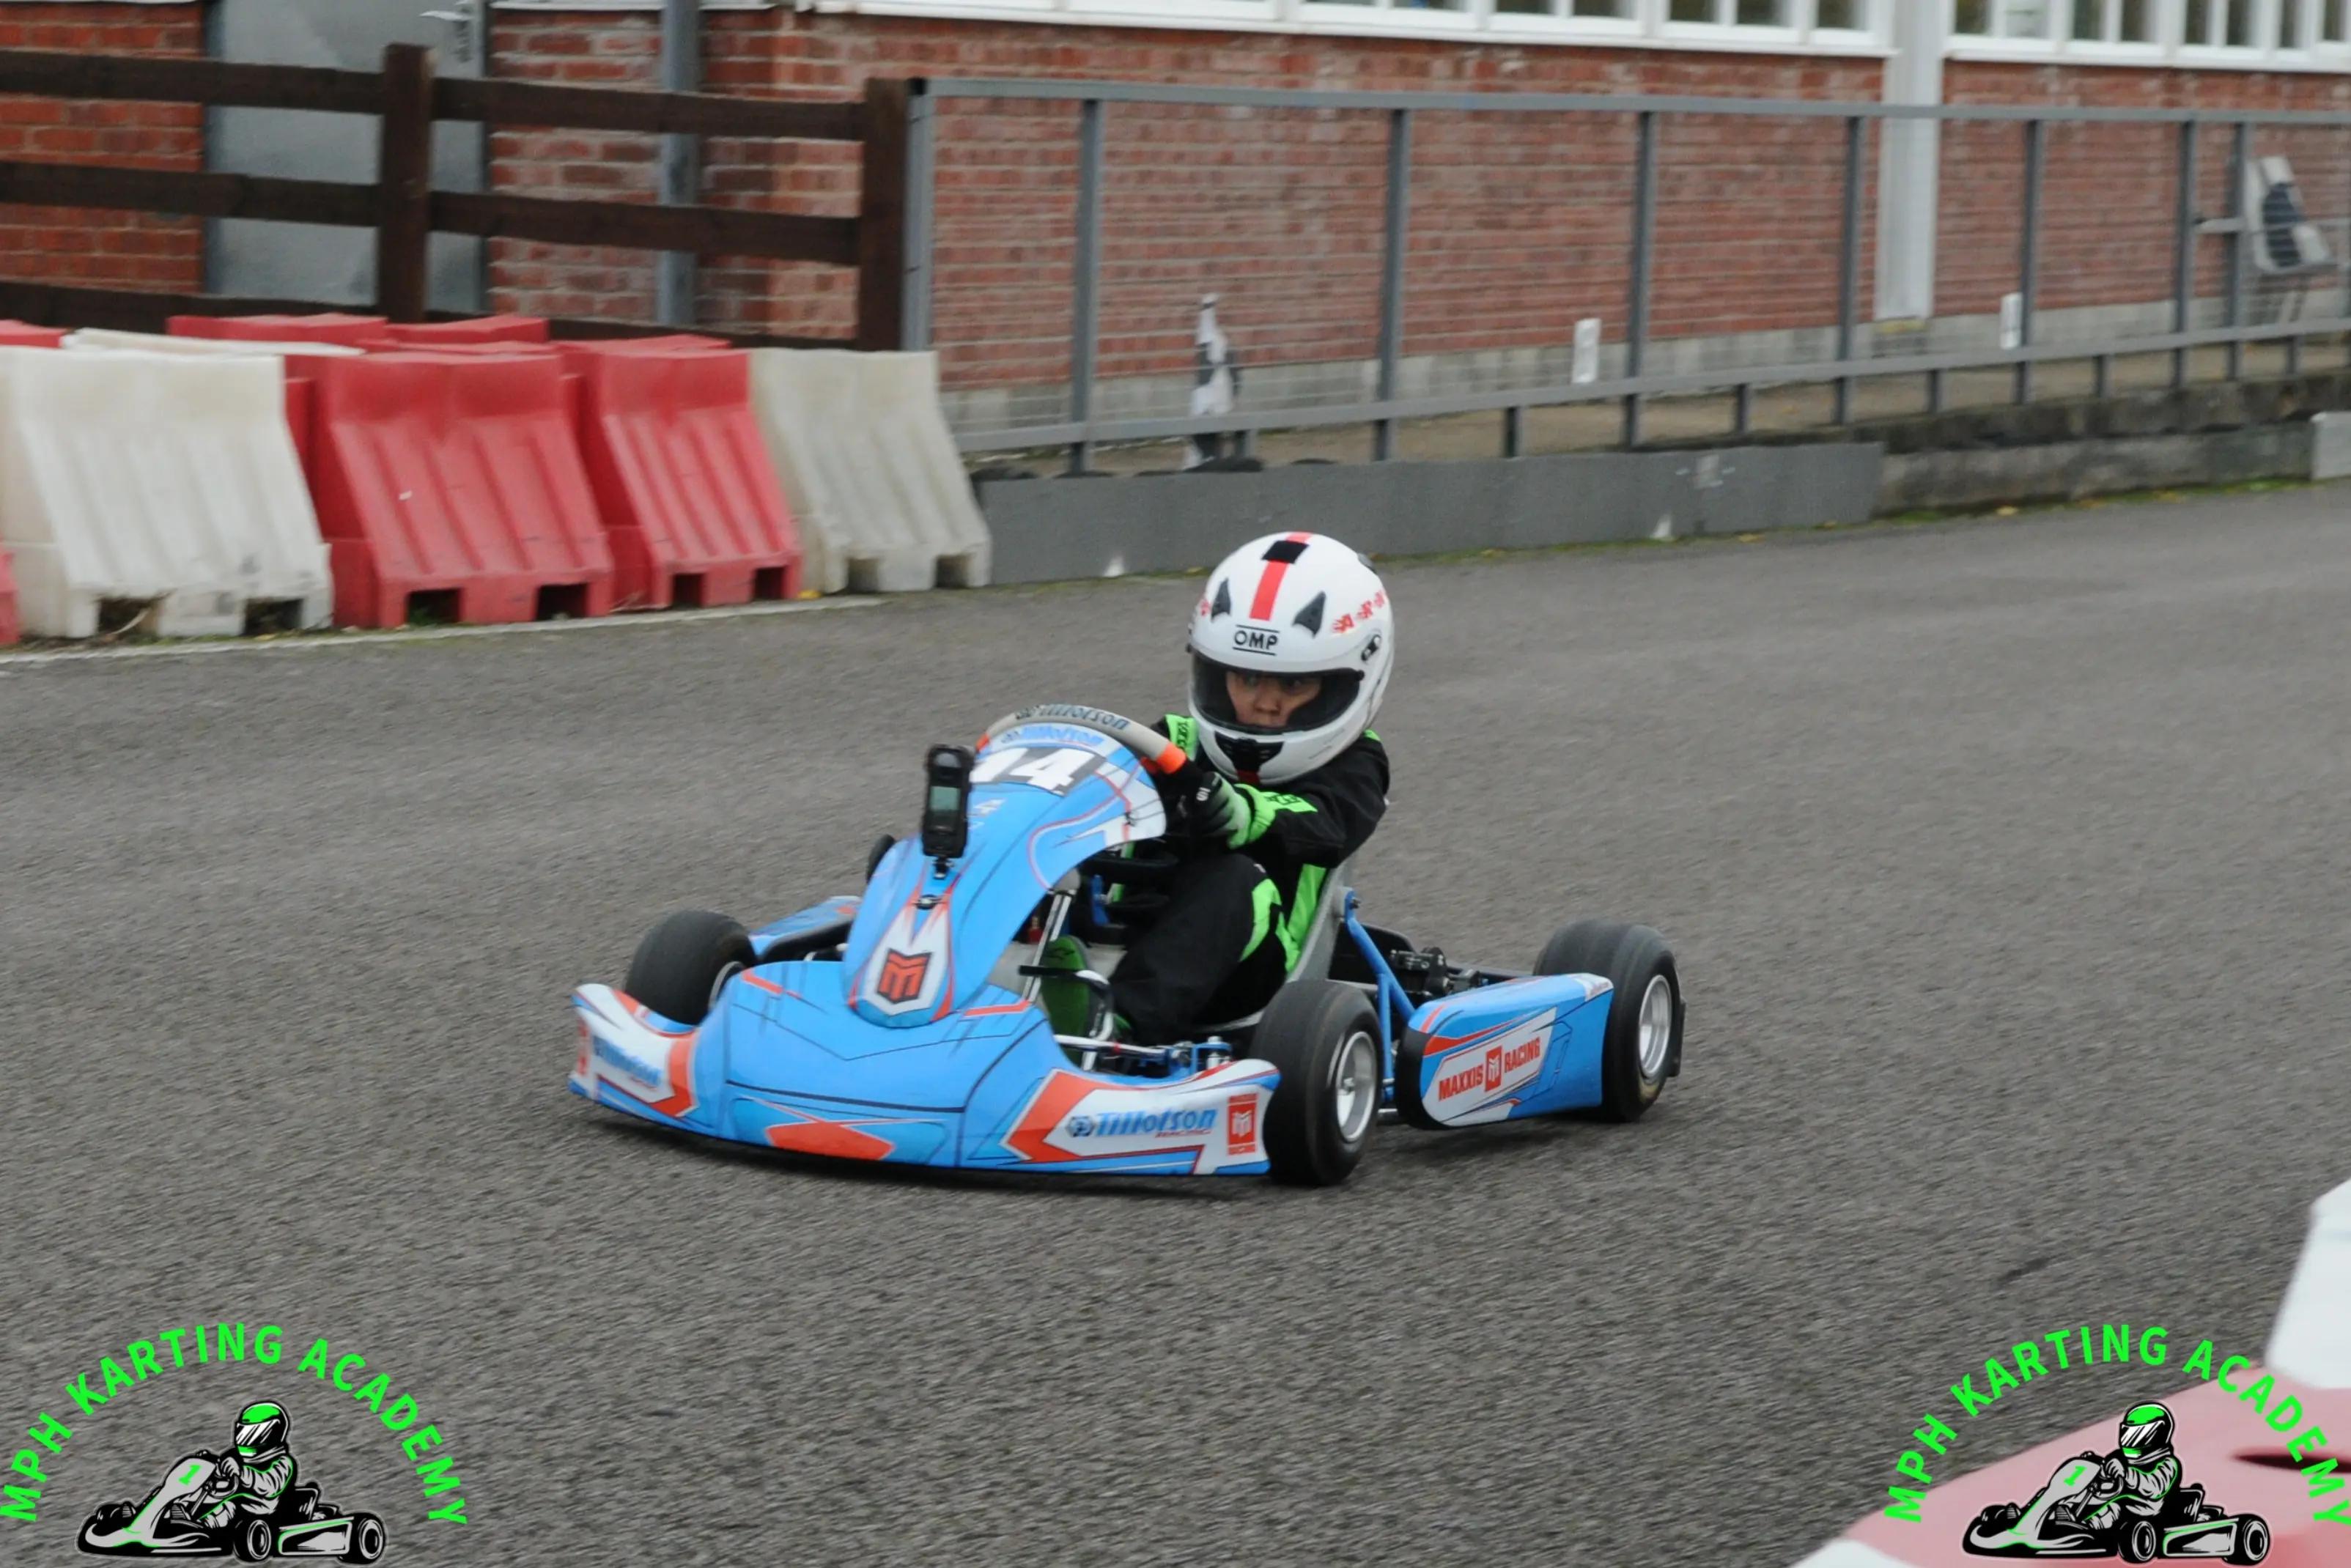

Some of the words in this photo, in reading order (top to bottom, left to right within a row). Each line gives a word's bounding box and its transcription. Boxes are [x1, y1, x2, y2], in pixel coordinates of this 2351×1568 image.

[1233, 629, 1279, 651] OMP
[1439, 1064, 1484, 1101] MAXXIS
[1505, 1036, 1540, 1073] RACING
[1096, 1109, 1218, 1136] Tillotson
